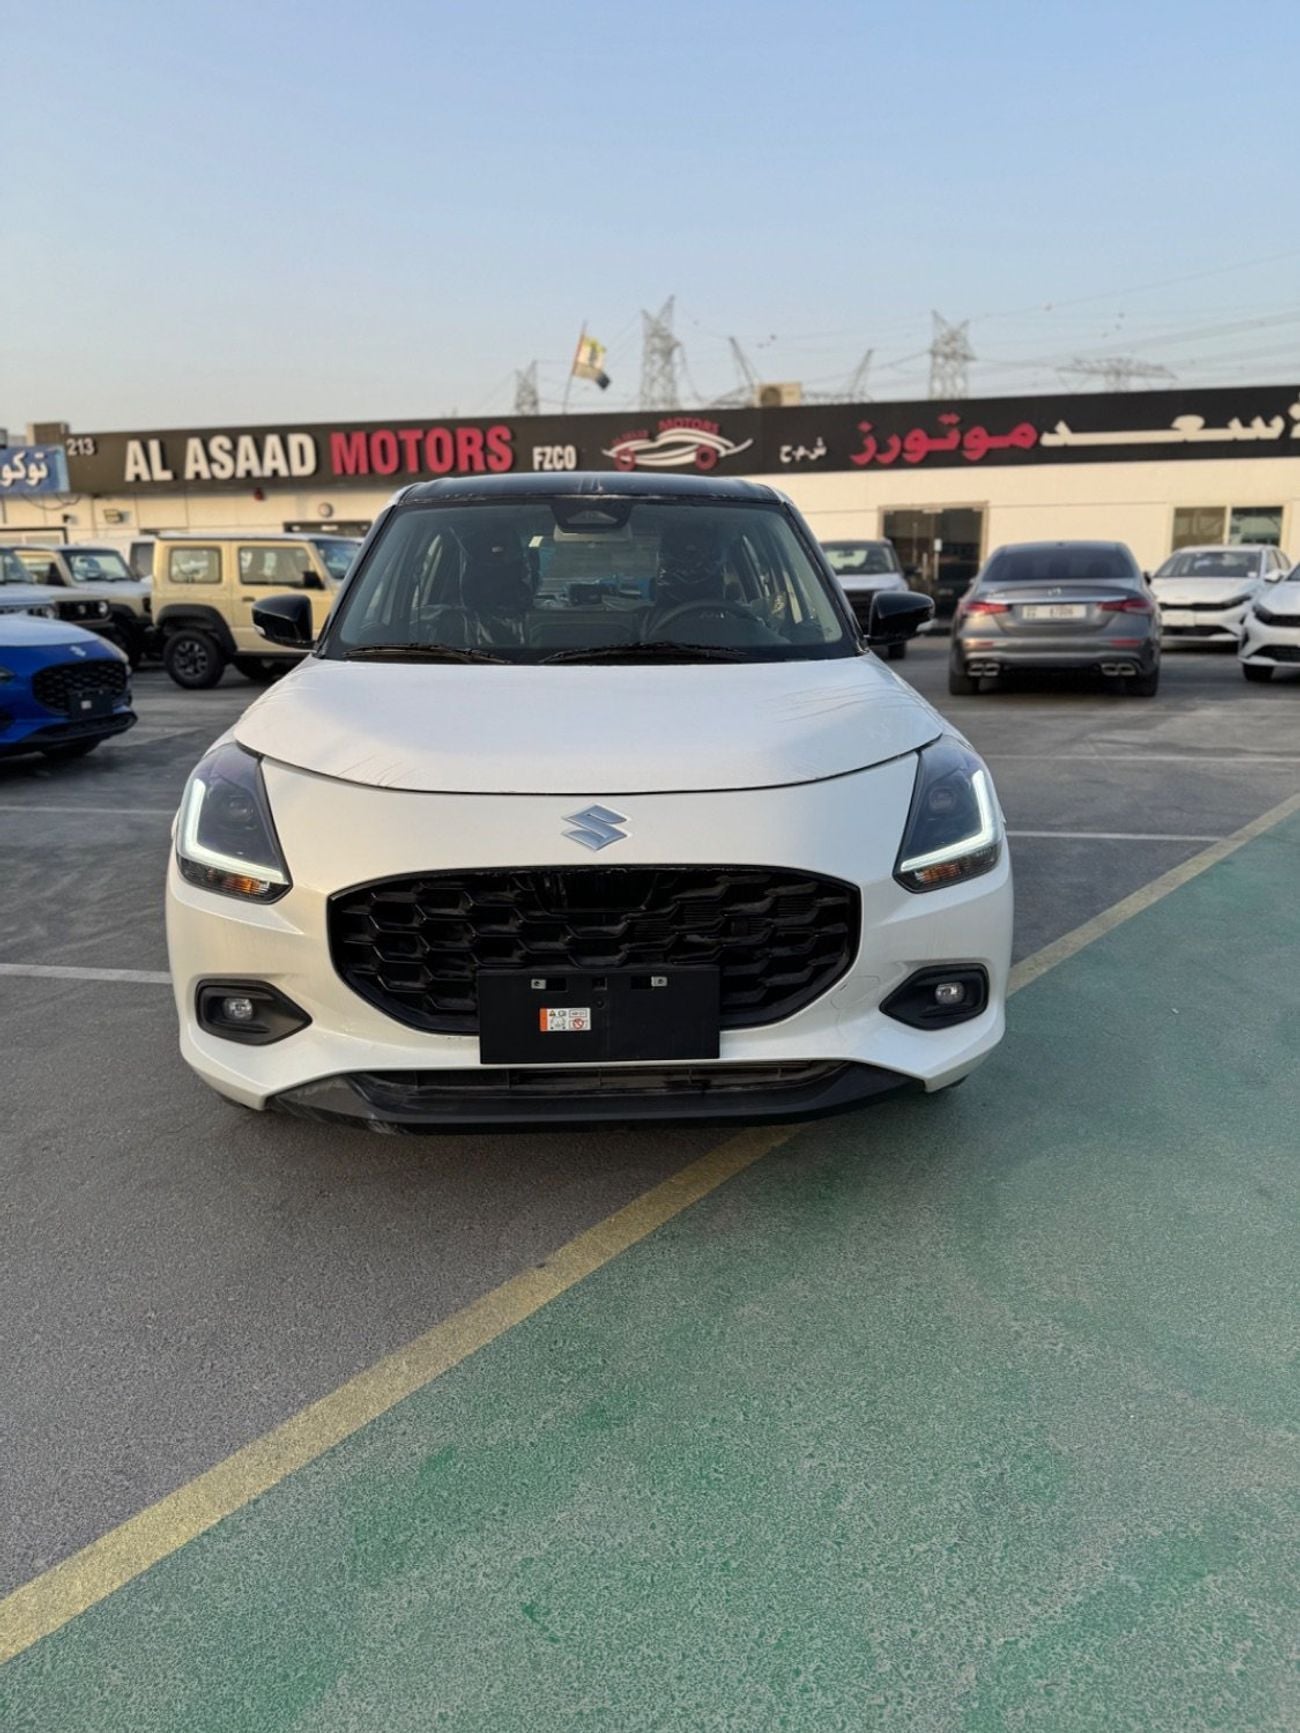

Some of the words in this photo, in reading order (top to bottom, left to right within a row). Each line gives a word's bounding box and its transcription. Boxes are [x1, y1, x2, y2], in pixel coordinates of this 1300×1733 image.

[66, 437, 96, 456] 213
[125, 439, 173, 482] AL
[185, 433, 317, 480] ASAAD
[330, 425, 514, 475] MOTORS
[532, 445, 577, 471] FZCO
[850, 412, 1038, 465] موتورز
